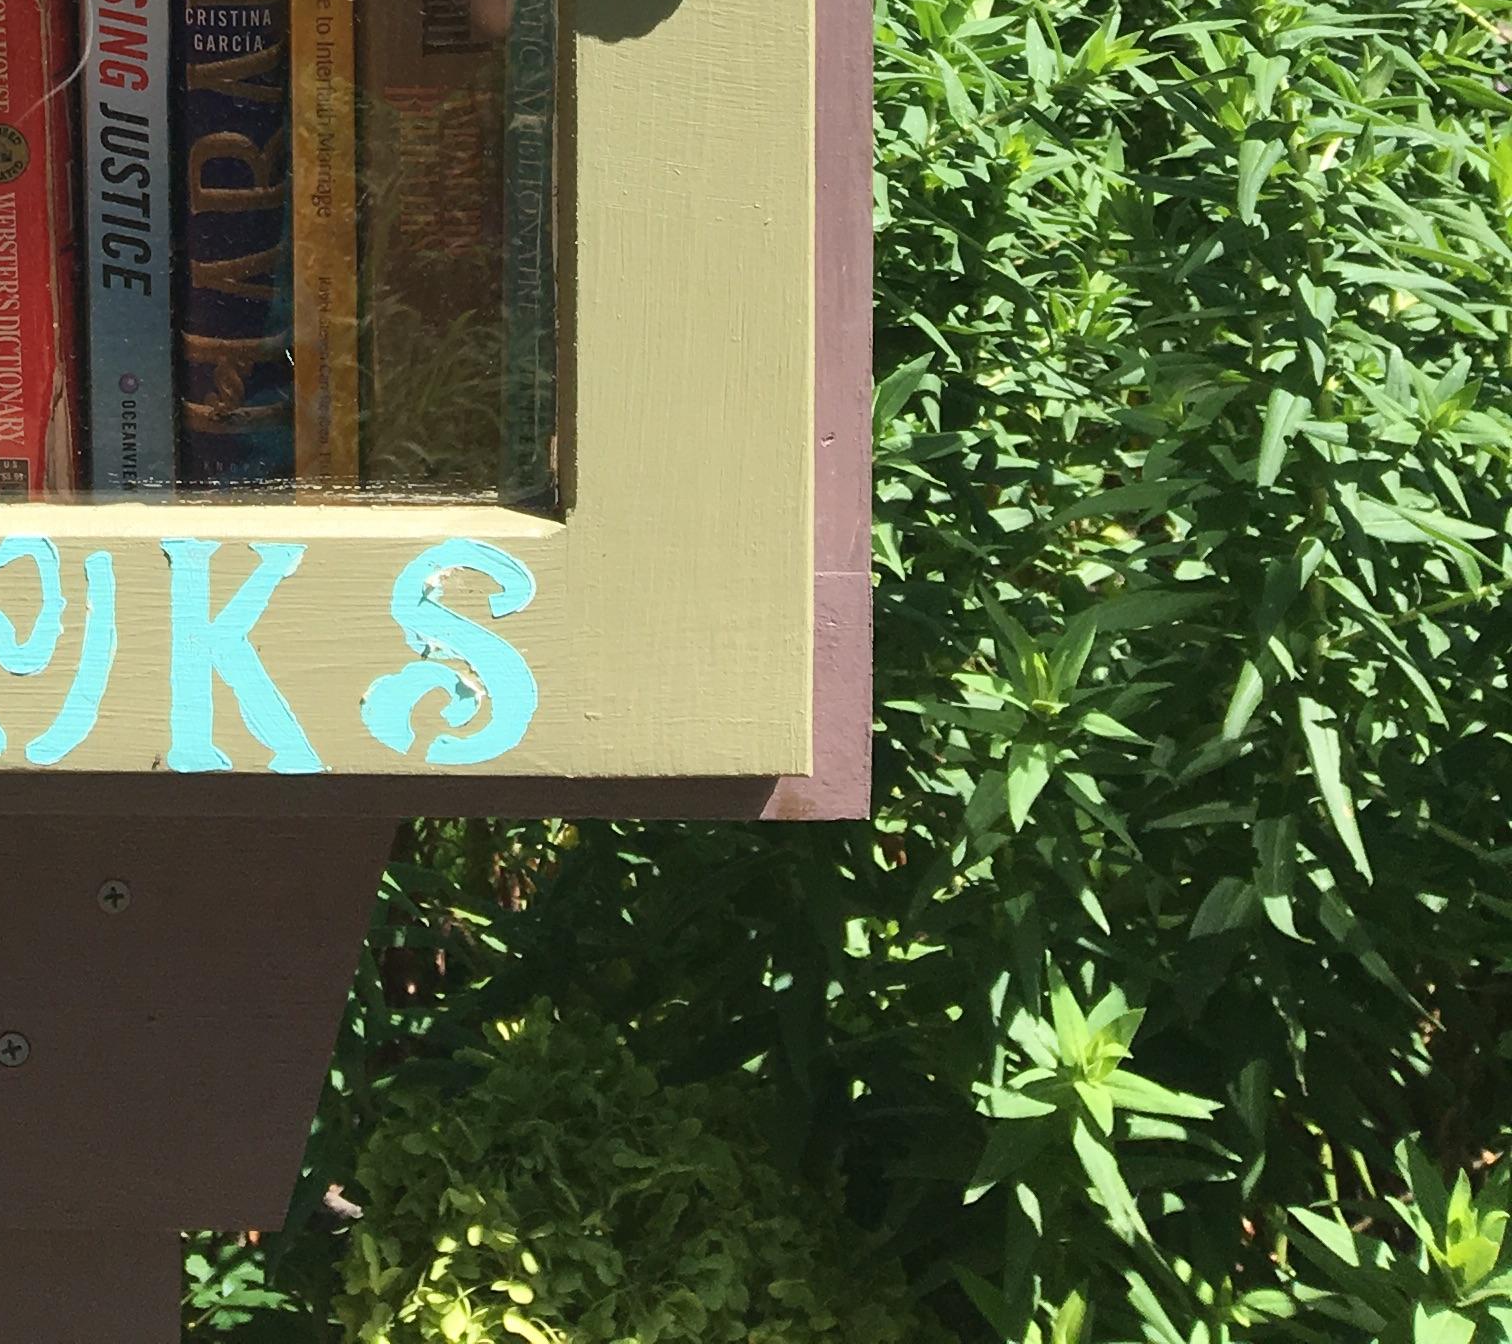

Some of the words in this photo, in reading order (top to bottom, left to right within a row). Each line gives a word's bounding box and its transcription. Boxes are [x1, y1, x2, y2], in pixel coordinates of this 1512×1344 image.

[184, 7, 273, 27] CRISTINA
[315, 15, 335, 35] to
[193, 29, 265, 53] GARCÍA
[310, 131, 336, 219] Marriage
[99, 101, 152, 297] JUSTICE
